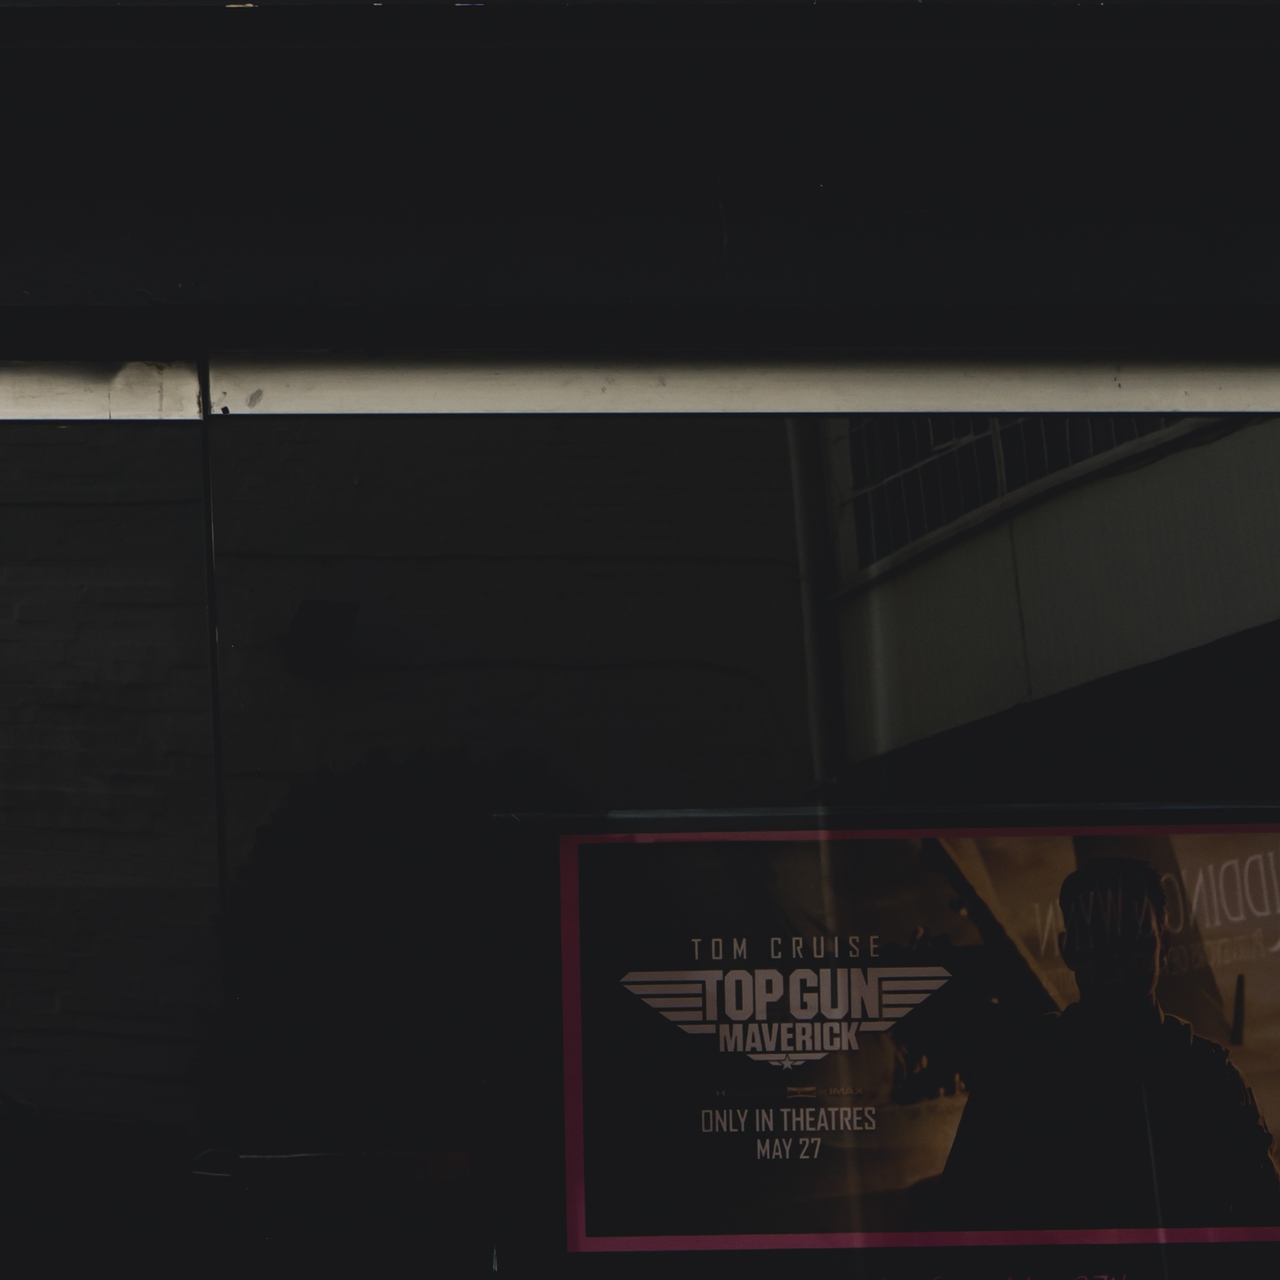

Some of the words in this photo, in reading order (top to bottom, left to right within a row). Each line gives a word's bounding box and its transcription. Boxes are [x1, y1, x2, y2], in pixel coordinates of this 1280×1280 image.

[691, 937, 748, 961] TOM
[770, 935, 880, 960] CRUISE
[702, 968, 785, 1022] TOP
[789, 966, 880, 1021] GUN
[718, 1021, 860, 1053] MAVERICK
[701, 1108, 748, 1134] ONLY
[755, 1109, 774, 1133] IN
[780, 1106, 877, 1132] THEATRES
[756, 1138, 793, 1160] MAY
[799, 1136, 822, 1160] 27
